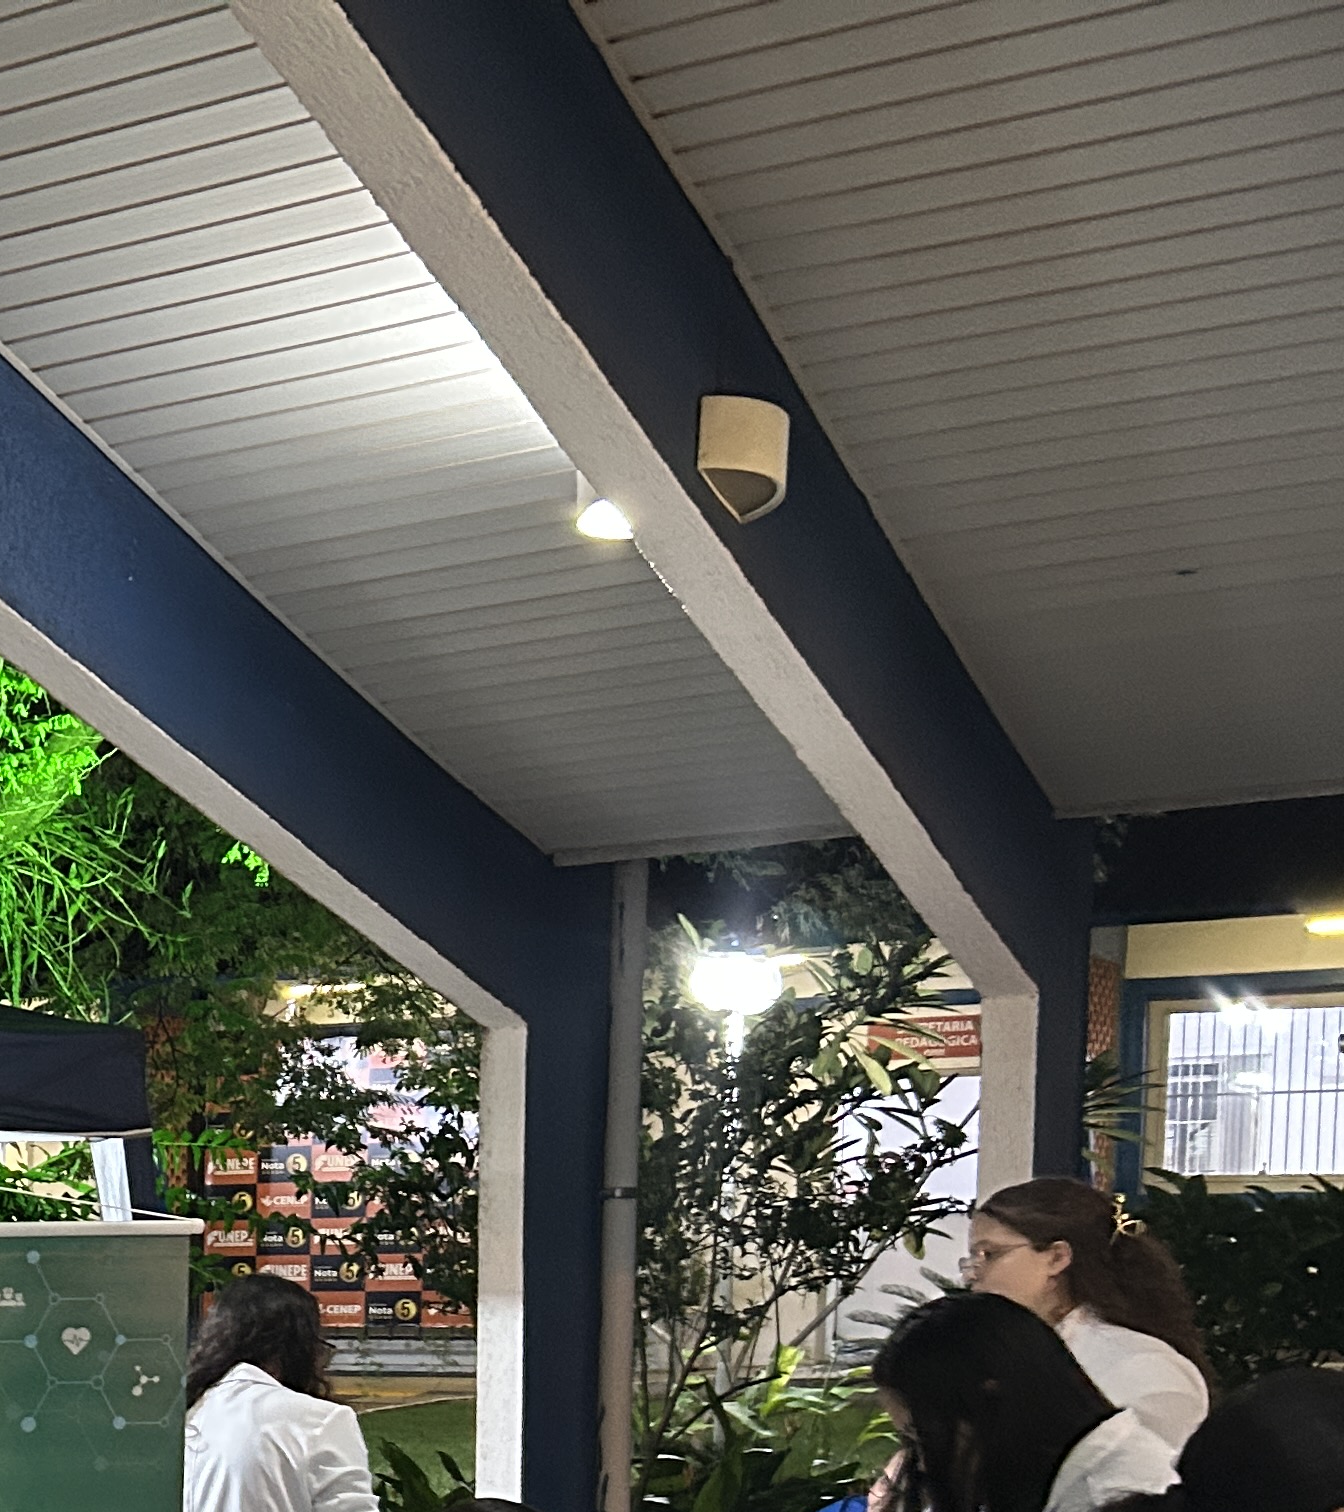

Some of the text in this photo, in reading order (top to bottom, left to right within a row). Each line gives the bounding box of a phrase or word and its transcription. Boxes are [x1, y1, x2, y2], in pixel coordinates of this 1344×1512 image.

[261, 1162, 285, 1170] Nota
[207, 1230, 254, 1246] FUNEP
[314, 1269, 338, 1277] Nota
[326, 1304, 362, 1315] CENEP
[369, 1306, 394, 1315] Nota
